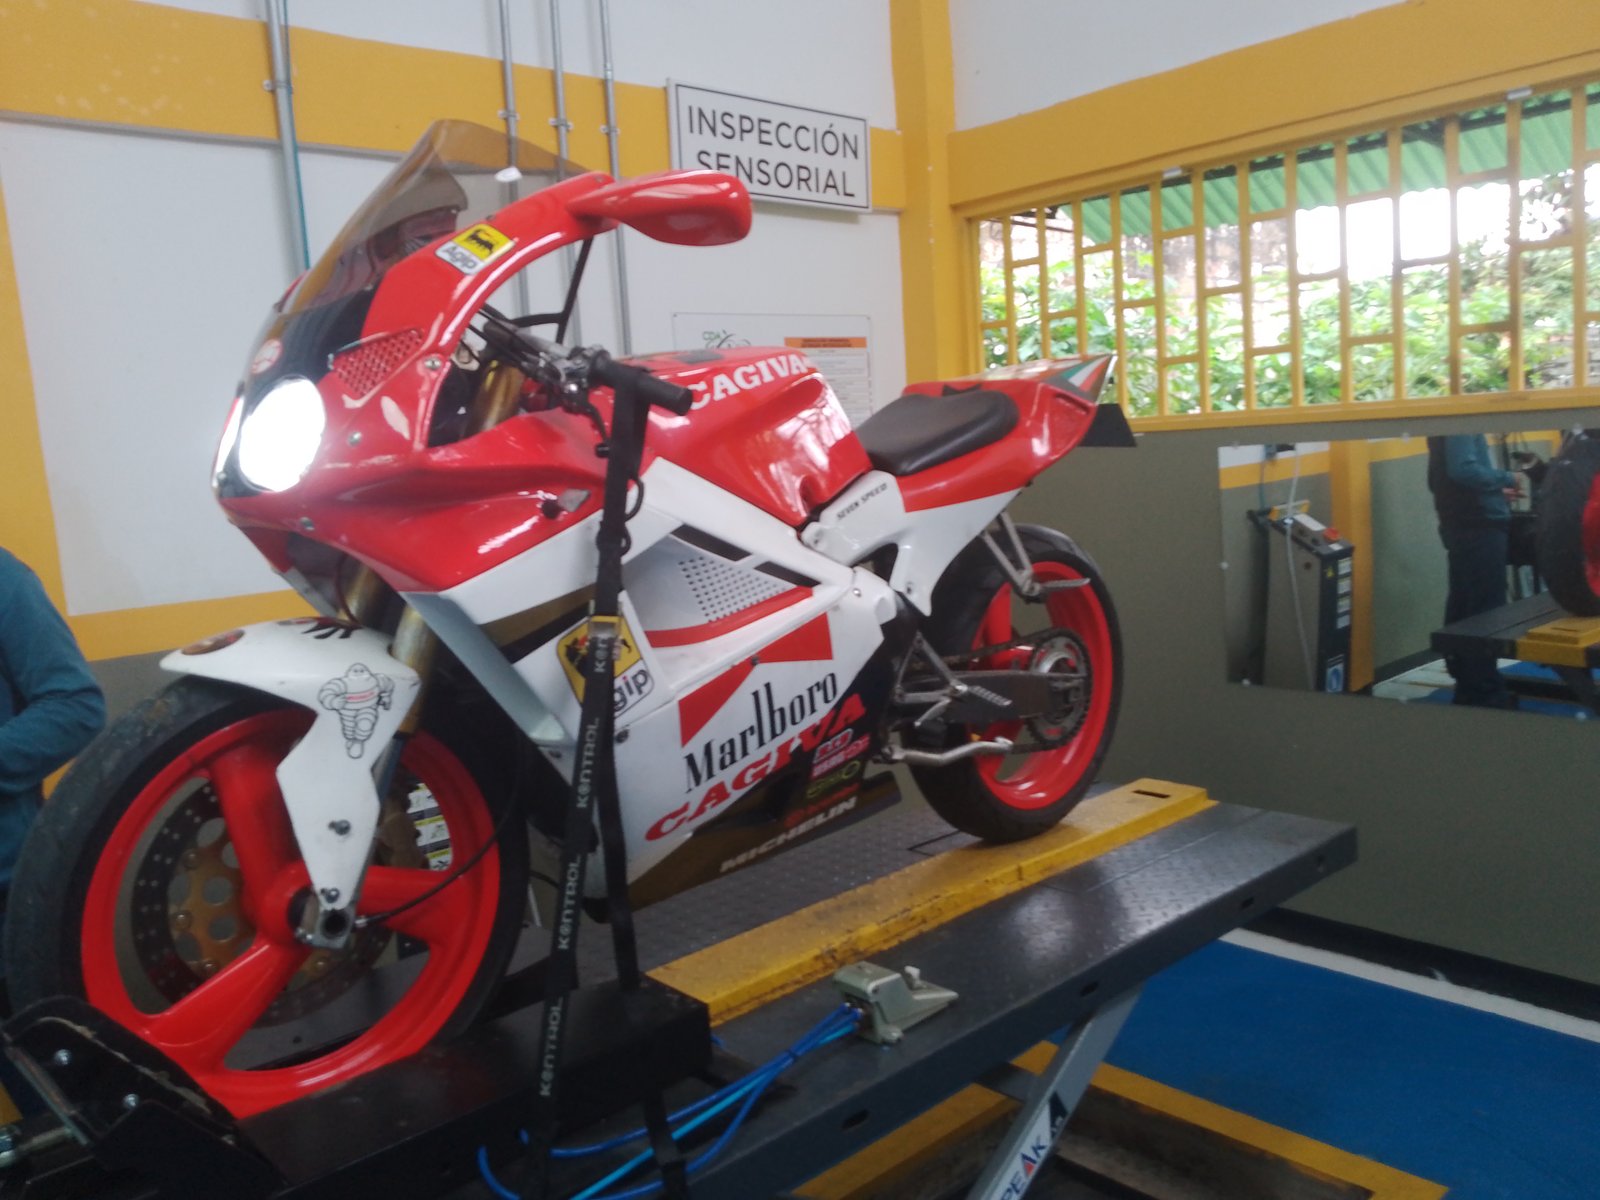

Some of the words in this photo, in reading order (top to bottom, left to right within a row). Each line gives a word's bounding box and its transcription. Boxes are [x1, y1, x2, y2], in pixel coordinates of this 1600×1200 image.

[688, 104, 860, 160] INSPECCIÓN
[697, 150, 856, 197] SENSORIAL
[688, 353, 810, 410] CAGIVA
[614, 669, 649, 713] gip
[684, 672, 838, 794] Marlboro
[645, 693, 867, 842] CAGIVA
[719, 796, 857, 873] MICHELIN
